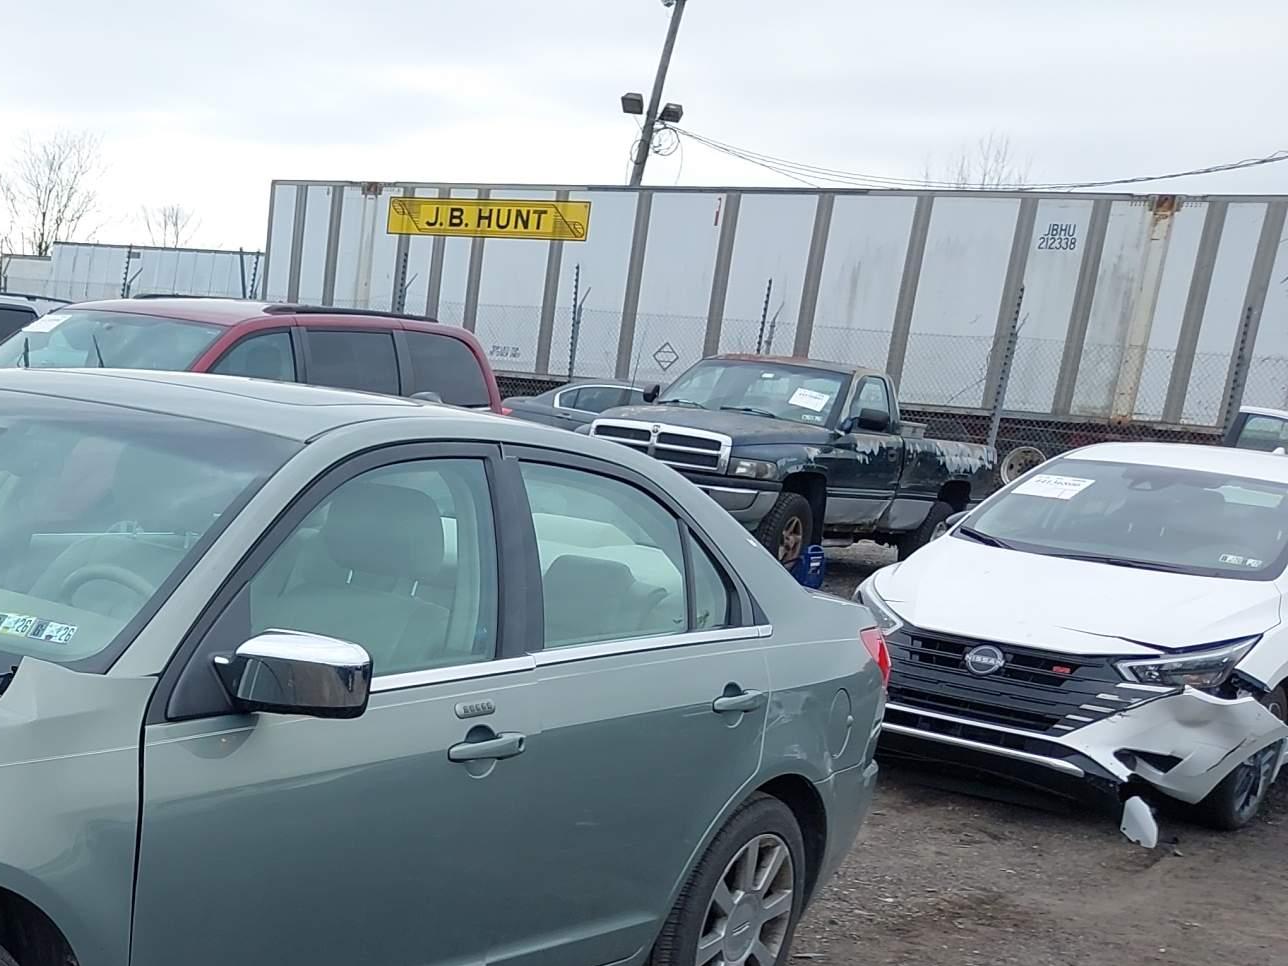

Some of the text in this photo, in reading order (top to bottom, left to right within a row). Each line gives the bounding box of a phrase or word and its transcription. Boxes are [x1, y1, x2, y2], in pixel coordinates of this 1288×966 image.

[425, 206, 548, 231] J.B. HUNT
[1043, 223, 1077, 238] JBHU
[1037, 236, 1078, 251] 212338
[964, 653, 1005, 668] NISSAN
